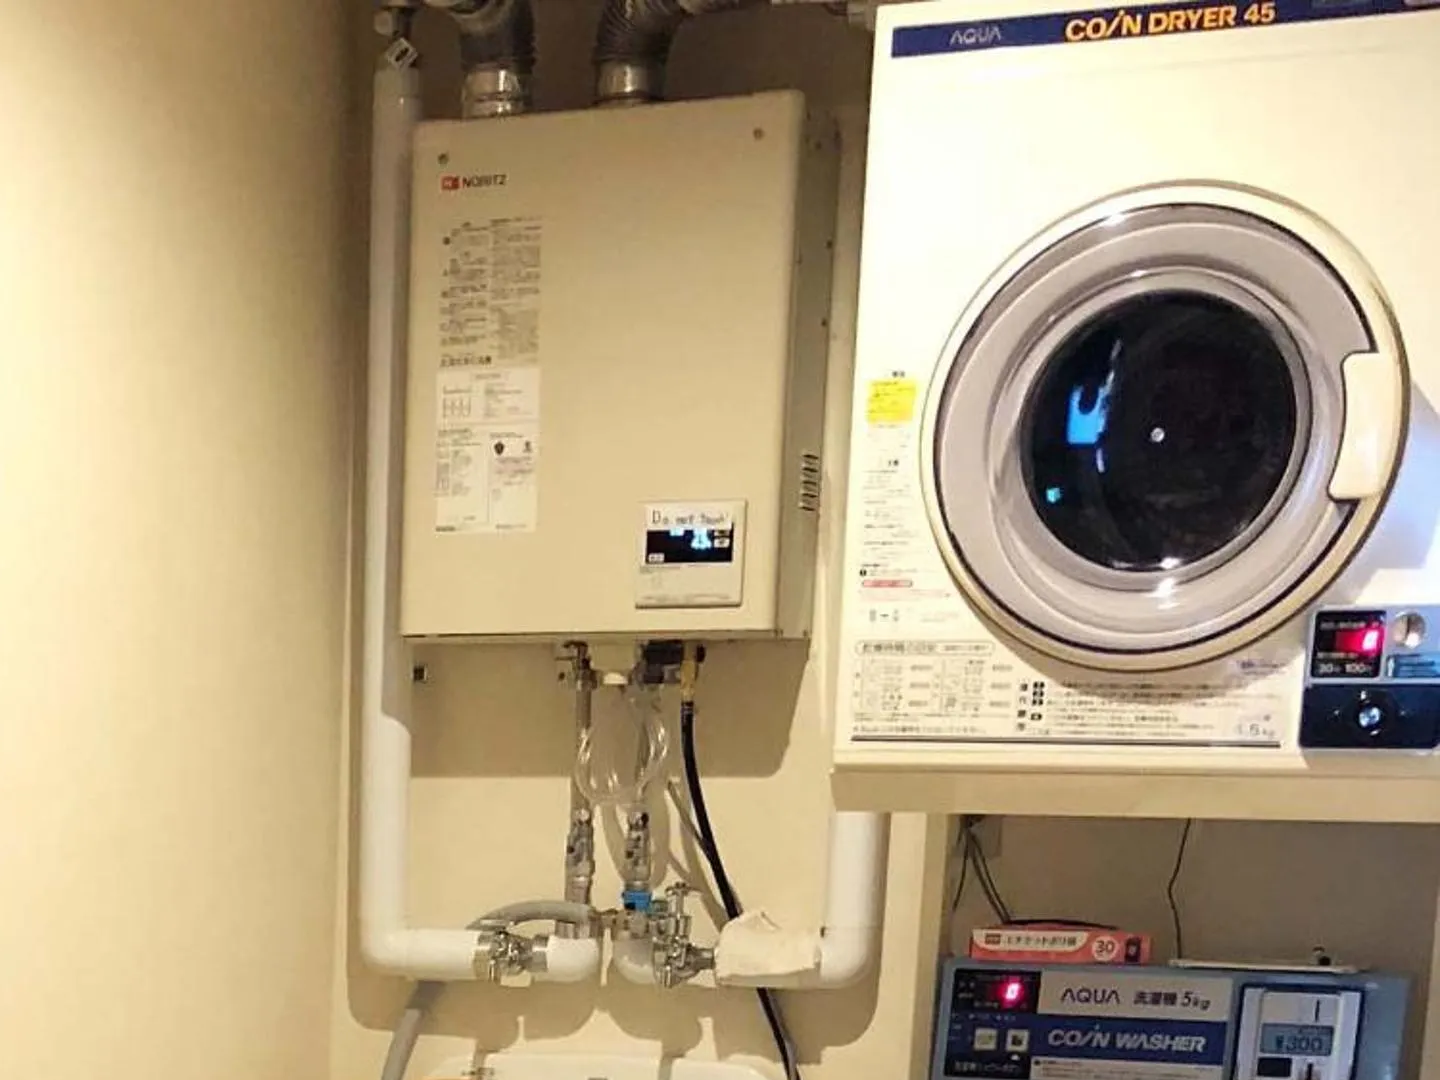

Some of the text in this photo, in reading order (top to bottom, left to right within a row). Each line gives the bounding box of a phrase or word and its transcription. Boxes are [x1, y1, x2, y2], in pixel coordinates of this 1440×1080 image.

[949, 25, 1002, 45] AQUA
[1148, 6, 1237, 33] DRYER
[1244, 2, 1276, 23] 45
[1095, 939, 1116, 955] 30
[1061, 987, 1121, 1005] AQUA
[1115, 1034, 1207, 1053] WASHER
